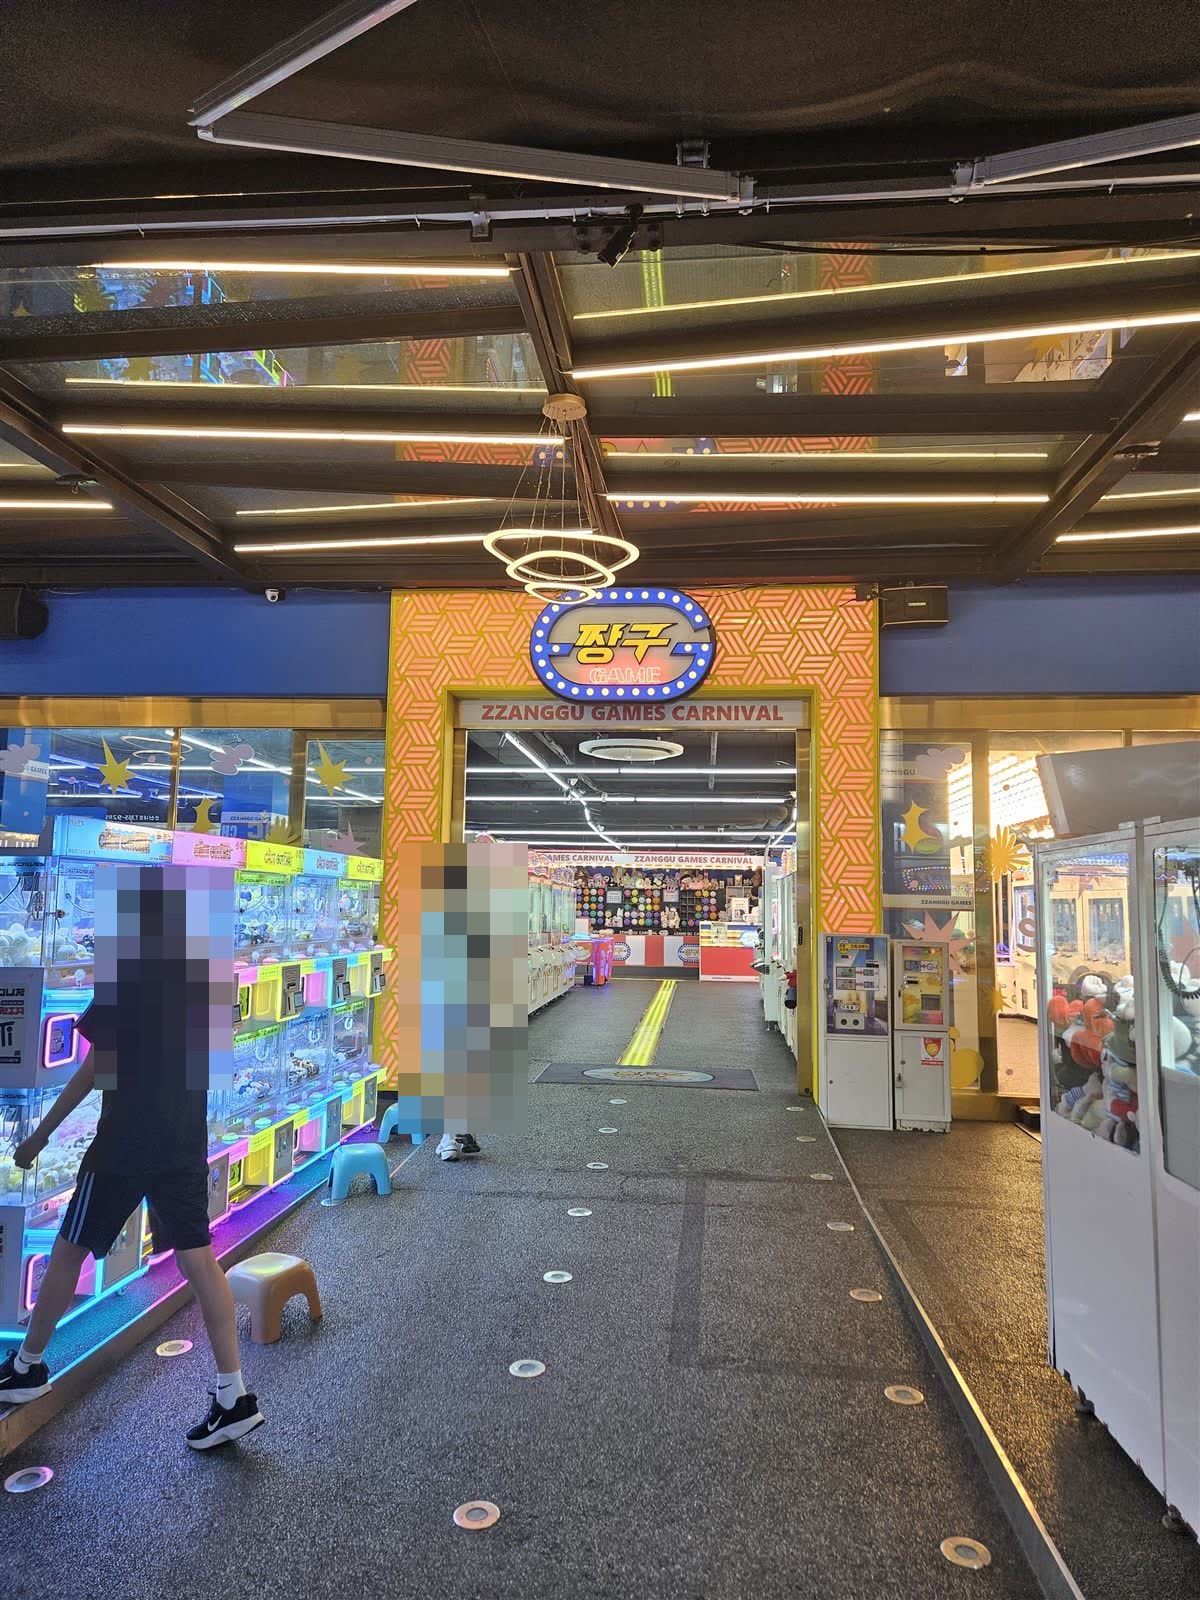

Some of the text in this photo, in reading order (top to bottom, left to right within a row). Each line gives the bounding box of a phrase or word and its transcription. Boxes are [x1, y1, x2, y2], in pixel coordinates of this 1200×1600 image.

[574, 622, 679, 665] 짱구
[589, 665, 662, 684] GAME
[481, 705, 784, 721] ZZANGGU GAMES CARNIVAL
[572, 854, 614, 862] CARNIVAL
[634, 855, 754, 864] ZZANGGU GAMES CARNIVAL
